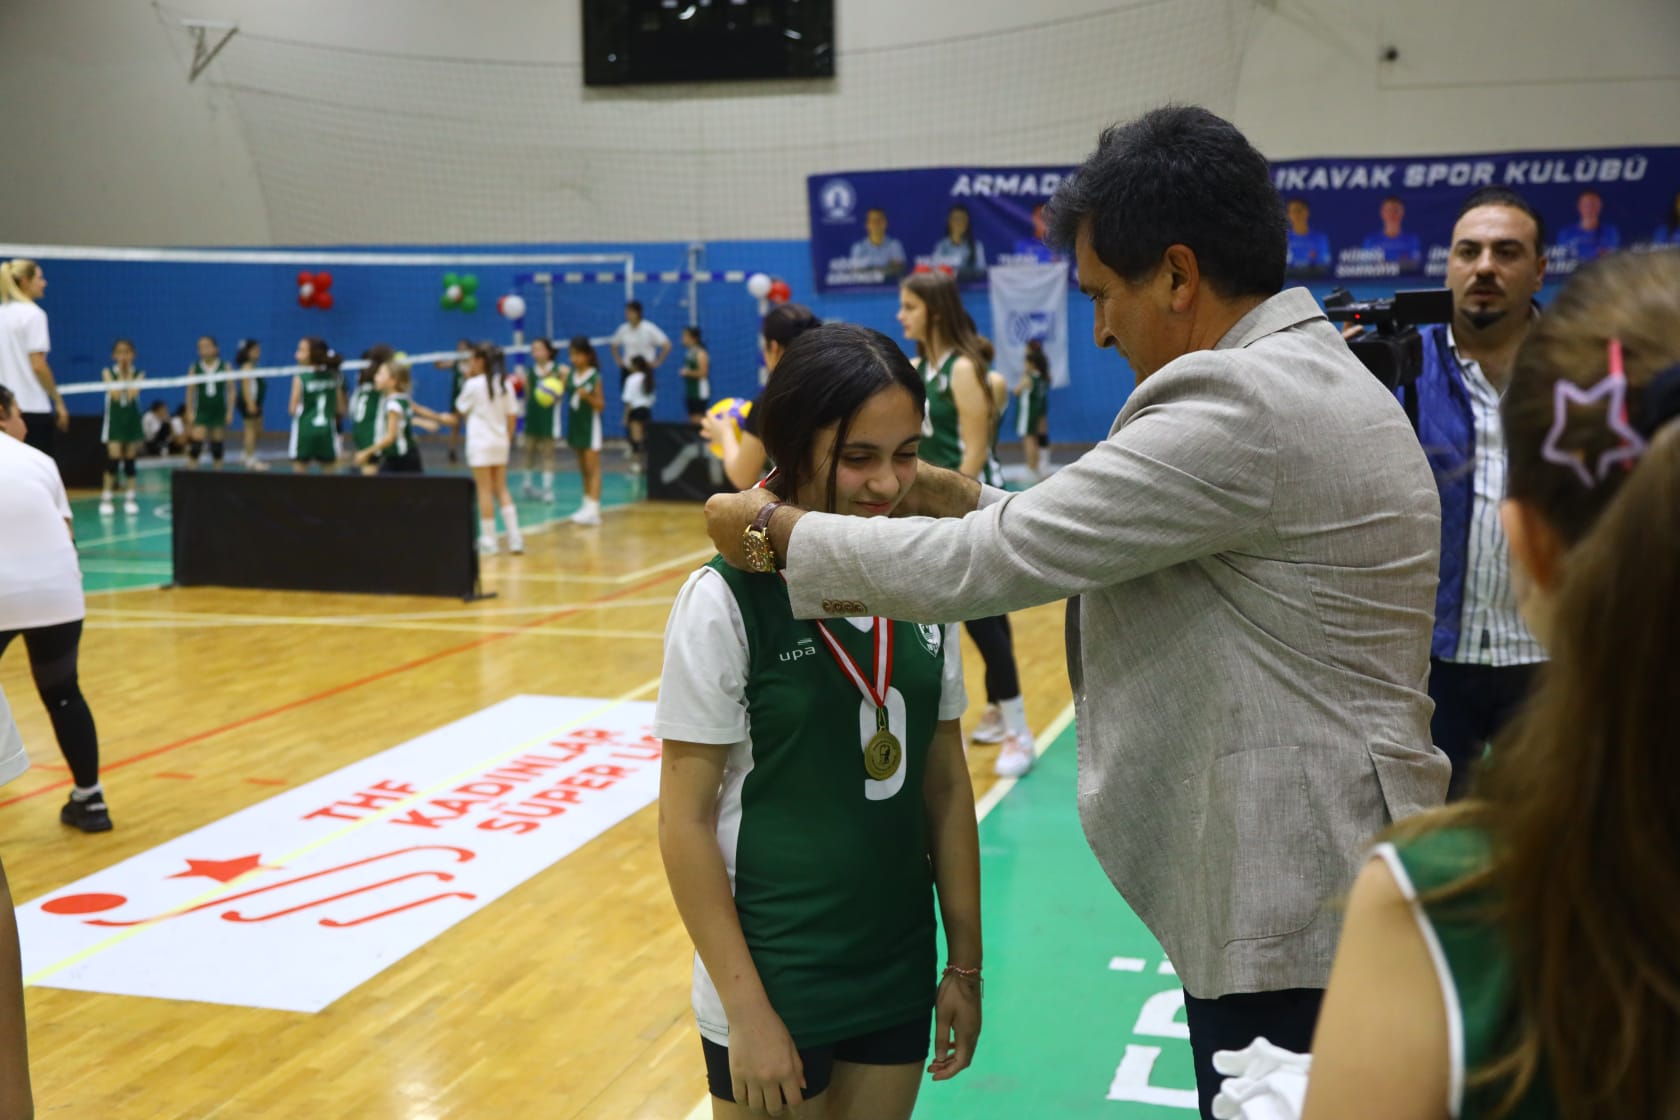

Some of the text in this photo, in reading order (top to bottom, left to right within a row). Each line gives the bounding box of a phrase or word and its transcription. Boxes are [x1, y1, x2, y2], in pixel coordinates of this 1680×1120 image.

[951, 174, 1064, 197] ARMAD
[1403, 161, 1496, 188] SPOR
[1503, 153, 1648, 185] KULÜBÜ
[778, 645, 817, 662] upa
[302, 779, 416, 821] THF
[388, 728, 624, 830] KADINLAR
[474, 764, 640, 835] SÜPER
